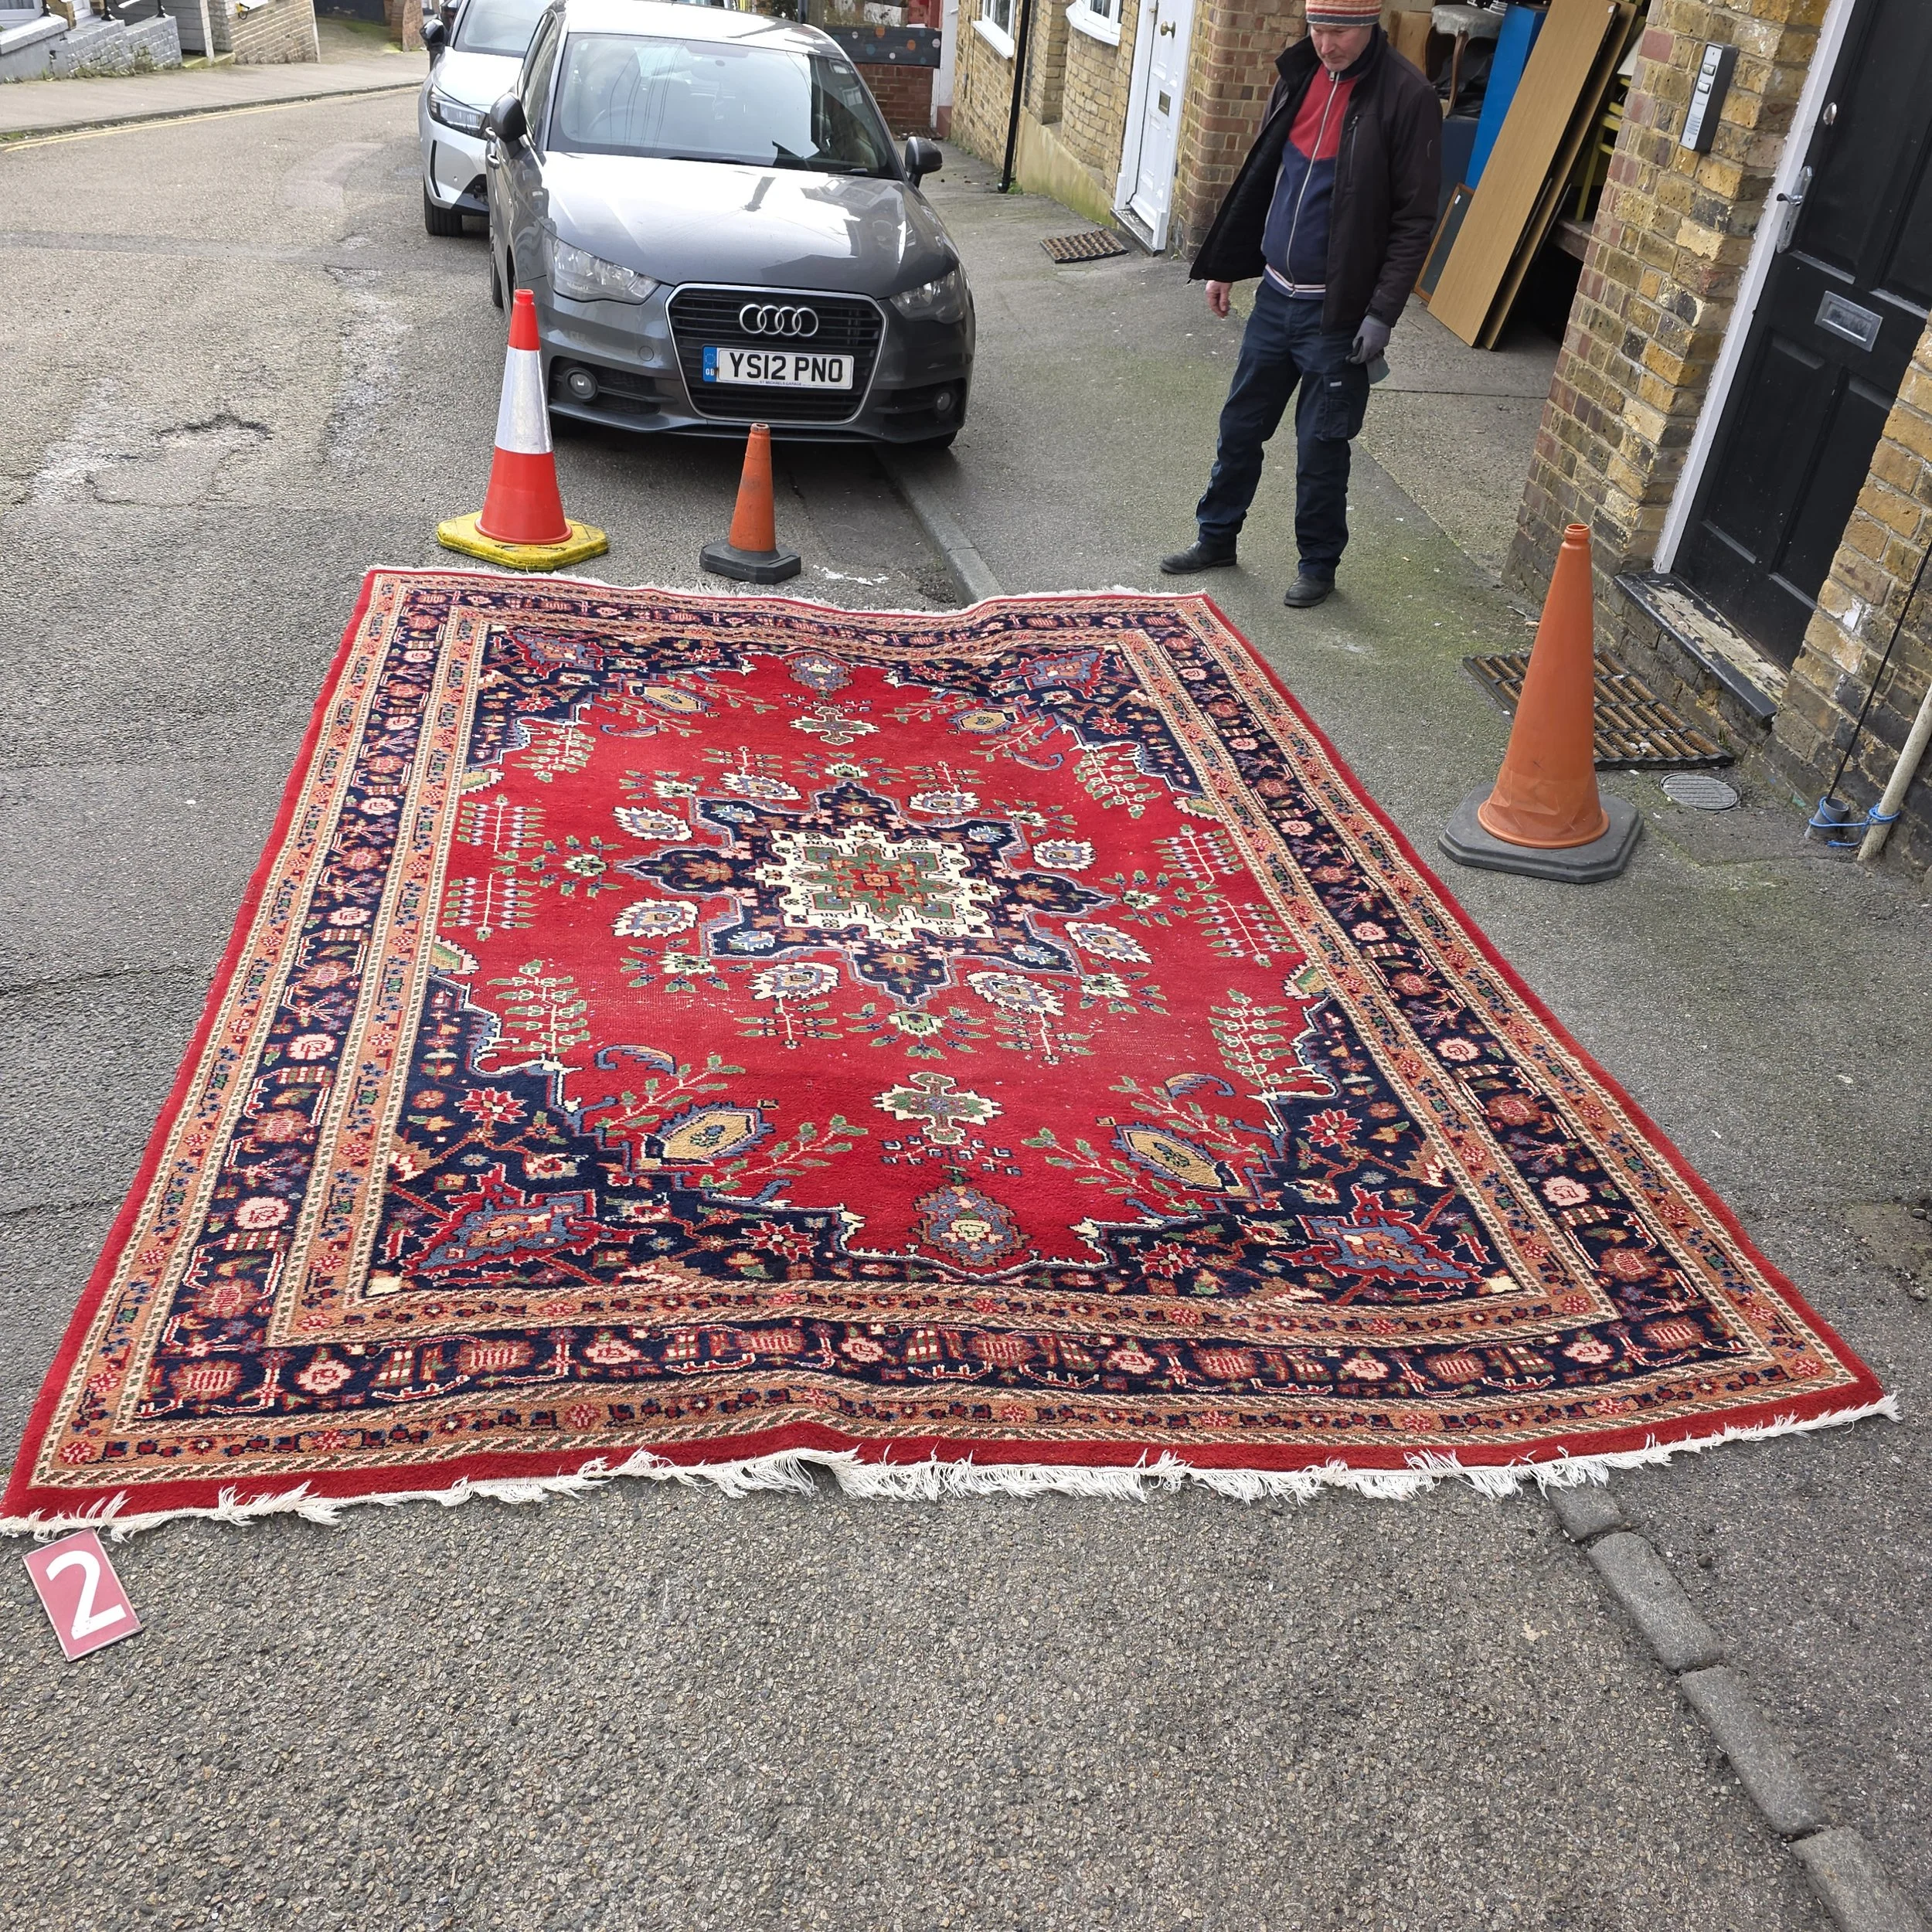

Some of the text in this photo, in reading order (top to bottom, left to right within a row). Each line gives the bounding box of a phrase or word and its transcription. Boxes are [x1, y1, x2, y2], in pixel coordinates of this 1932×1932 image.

[705, 368, 715, 376] GB
[730, 352, 843, 383] YS12 PNO
[46, 1550, 127, 1640] 2
